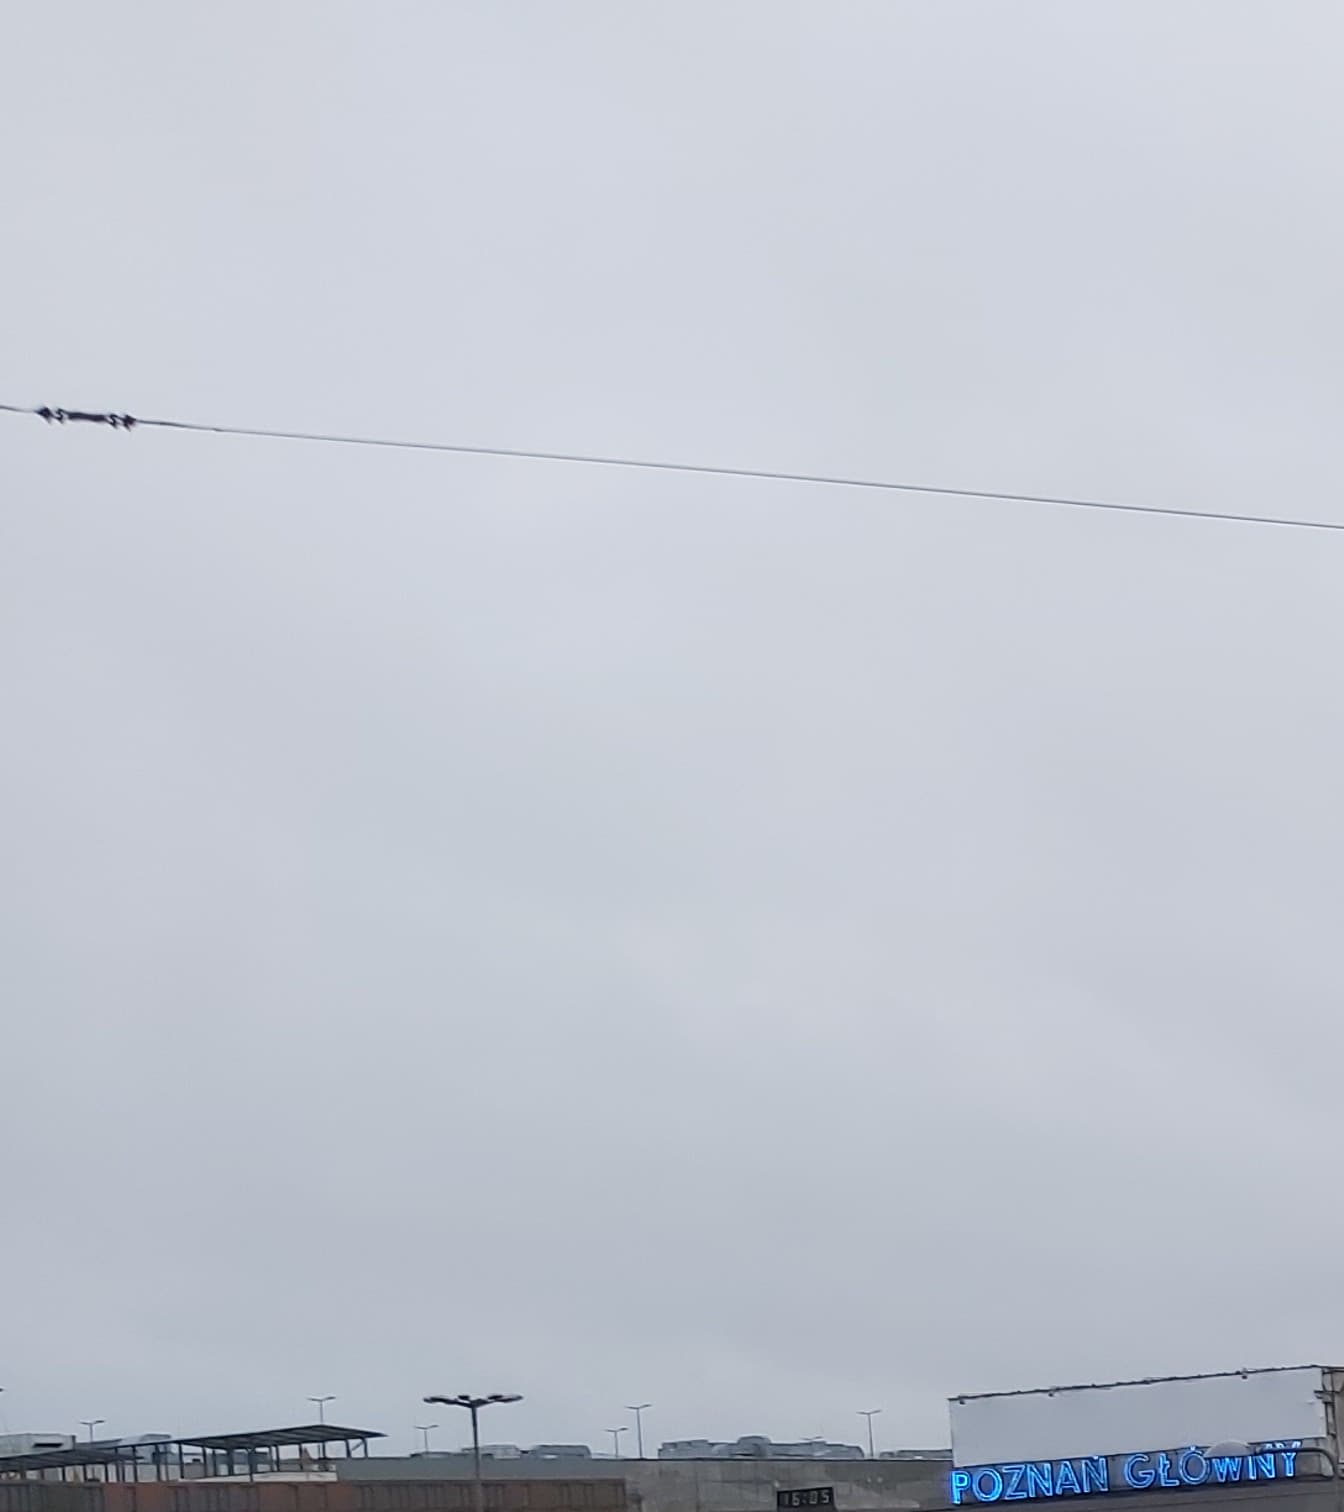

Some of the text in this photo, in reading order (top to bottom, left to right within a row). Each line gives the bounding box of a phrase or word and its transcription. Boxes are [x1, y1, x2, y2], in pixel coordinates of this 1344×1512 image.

[951, 1440, 1302, 1505] POZNAŃ GŁÓWNY
[783, 1489, 830, 1506] 16:05
